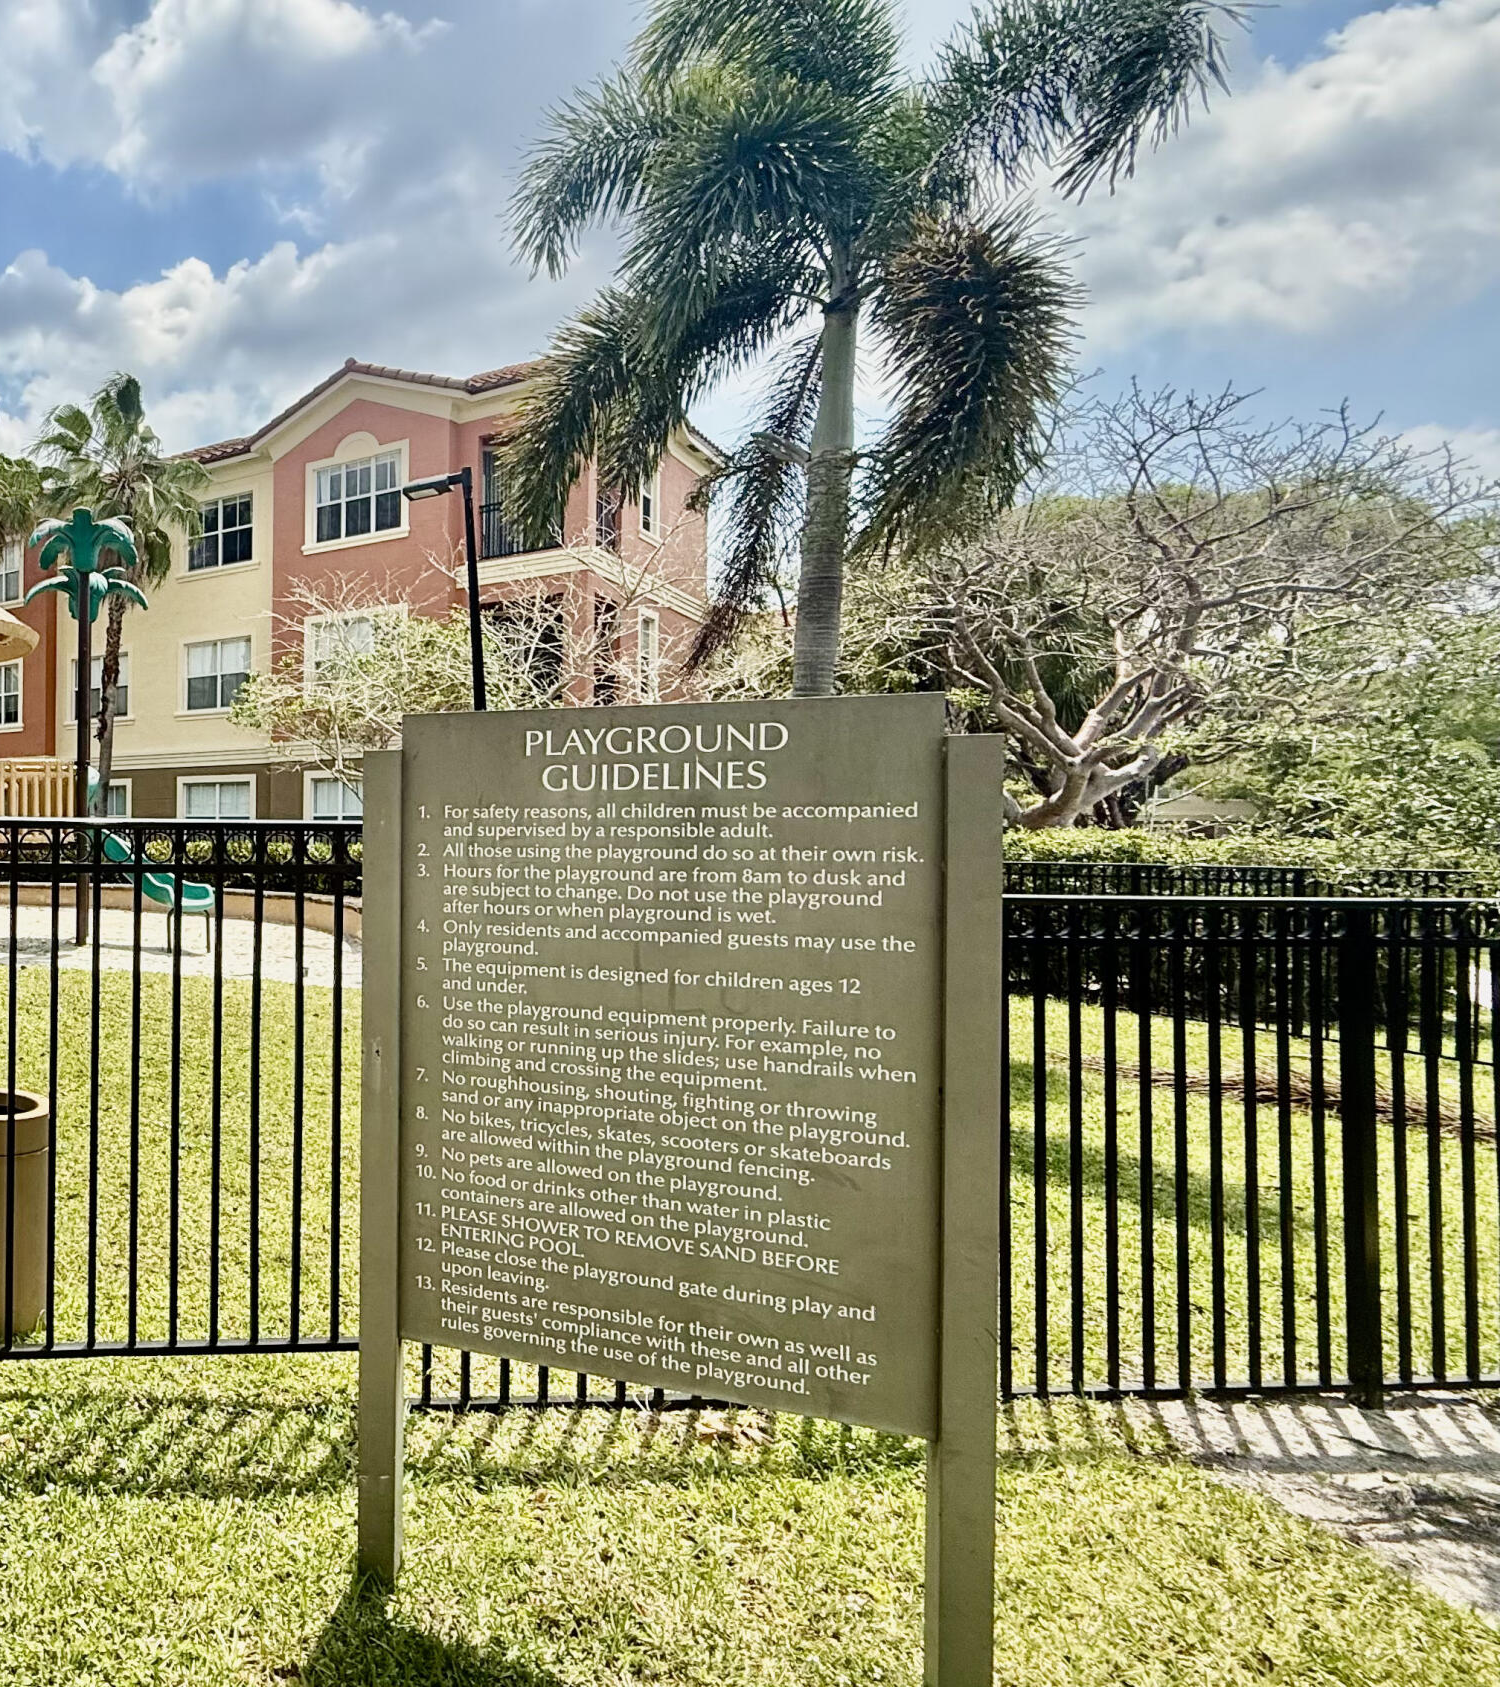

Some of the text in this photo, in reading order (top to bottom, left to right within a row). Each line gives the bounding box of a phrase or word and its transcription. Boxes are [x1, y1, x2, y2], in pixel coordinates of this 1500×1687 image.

[526, 722, 789, 756] PLAYGROUND
[542, 758, 767, 792] GUIDELINES
[418, 801, 918, 823] 1. For safety reasons, all children must be accompanied
[444, 822, 773, 842] and supervised by a responsible adult.
[417, 842, 924, 864] 2. All those using the playground do so at their own risk.
[417, 863, 905, 887] 3. Hours for the playground are from 8am to dusk and
[417, 919, 916, 954] 4. Only residents and accompanied guests may use the
[417, 995, 896, 1040] 6. Use the playground equipment properly. Failure to
[442, 1033, 916, 1083] walking or running up the slides; use handrails when
[442, 1049, 767, 1091] climbing and crossing the equipment.
[416, 1067, 877, 1129] 7. No roughhousing, shouting, fighting or throwing
[442, 1090, 910, 1148] sand or any inappropriate object on the playground.
[416, 1106, 891, 1170] 8. No bikes, tricycles, skates, scooters or skateboards
[415, 1143, 782, 1202] 9. No pets are allowed on the playground.
[416, 1164, 831, 1231] 10. No food or drinks other than water in plastic
[415, 1202, 839, 1275] 11. PLEASE SHOWER TO REMOVE SAND BEFORE
[441, 1222, 585, 1258] ENTERING POOL.
[415, 1237, 875, 1321] 12. Please close the playground gate during play and
[441, 1261, 550, 1293] upon leaving.
[415, 1275, 877, 1366] 13. Residents are responsible for their own as well as
[441, 1296, 871, 1385] their guests' compliance with these and all other
